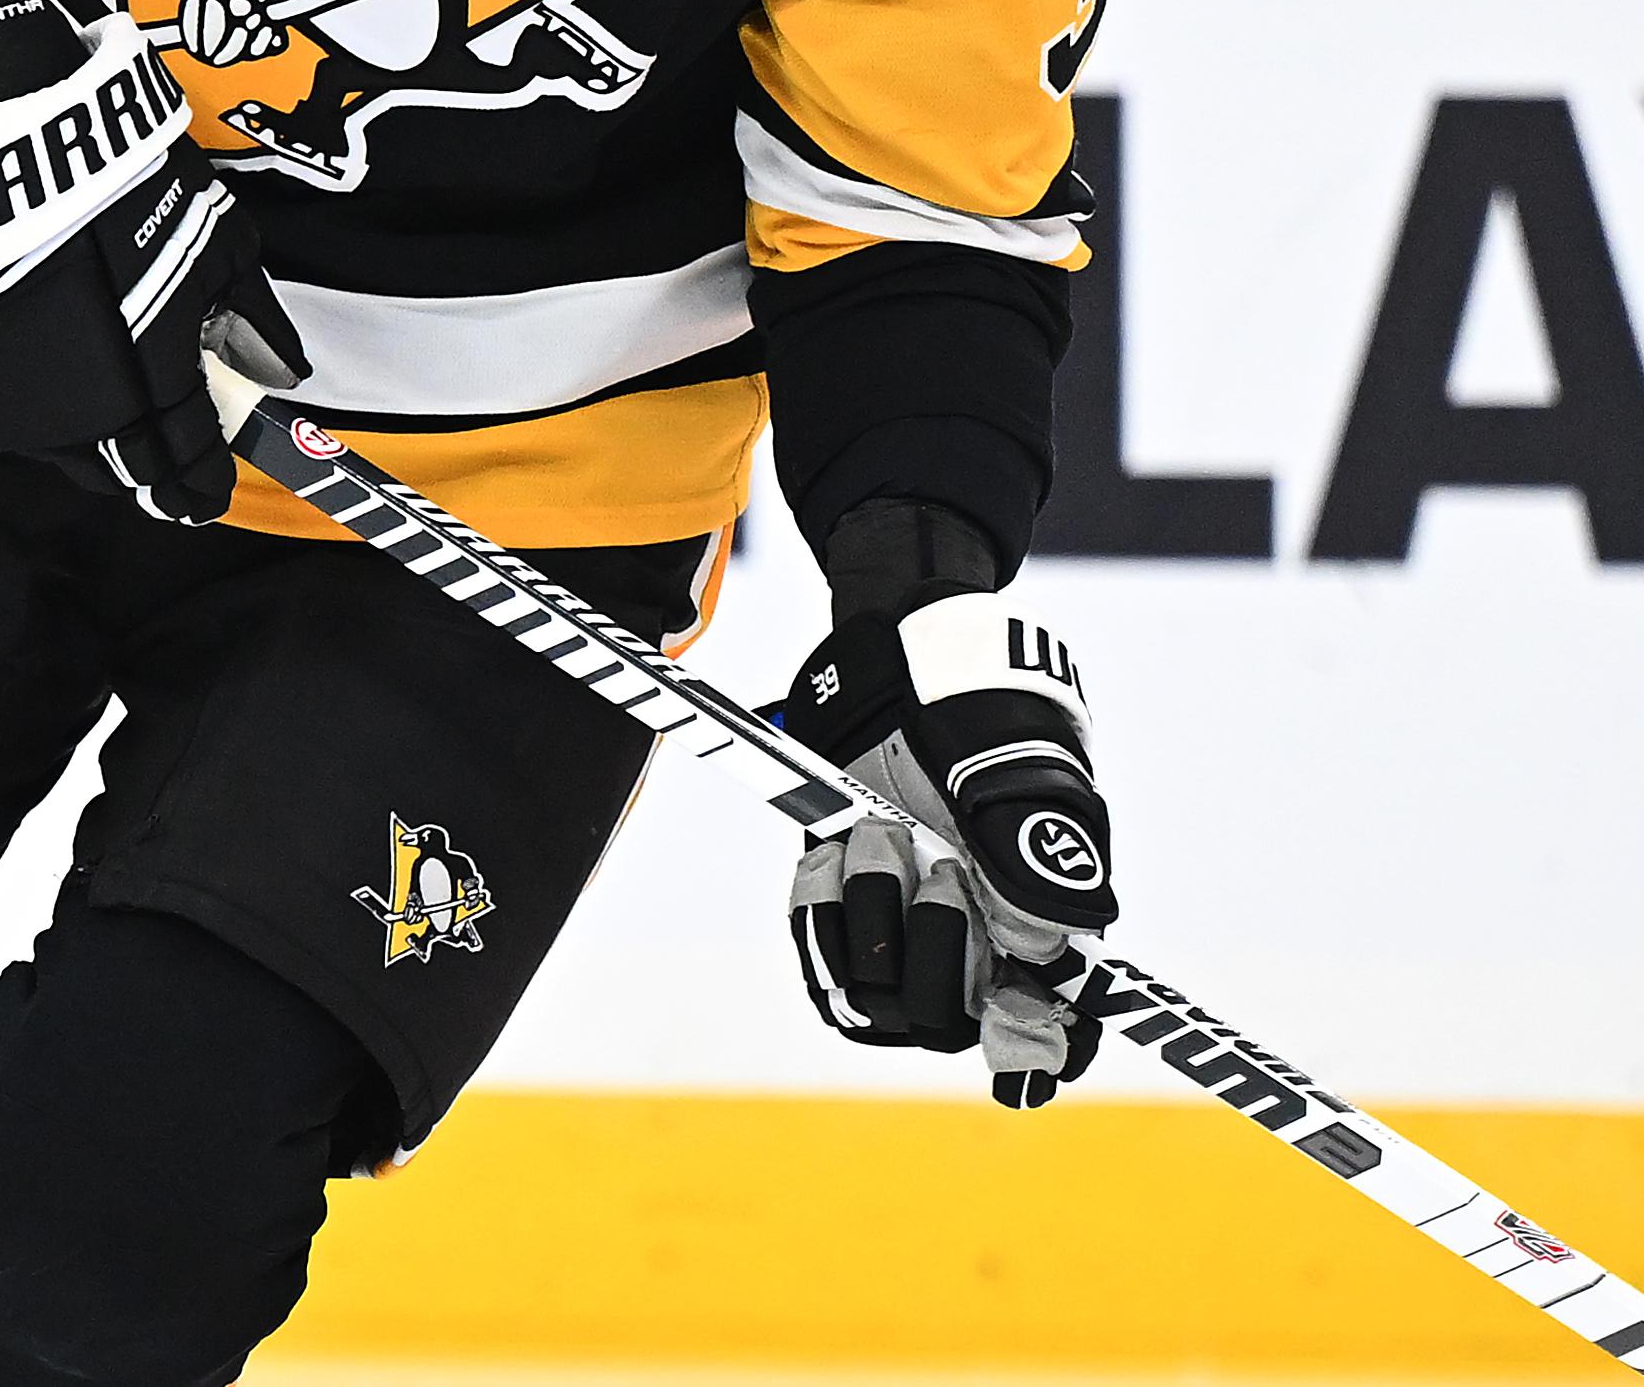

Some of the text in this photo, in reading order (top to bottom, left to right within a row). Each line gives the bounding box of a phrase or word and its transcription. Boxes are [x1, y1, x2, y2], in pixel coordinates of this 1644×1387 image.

[133, 178, 184, 249] COVERT
[379, 482, 702, 683] WARRIOR
[809, 663, 841, 706] 39
[838, 777, 919, 829] MANTHA
[1041, 947, 1307, 1132] VIUM
